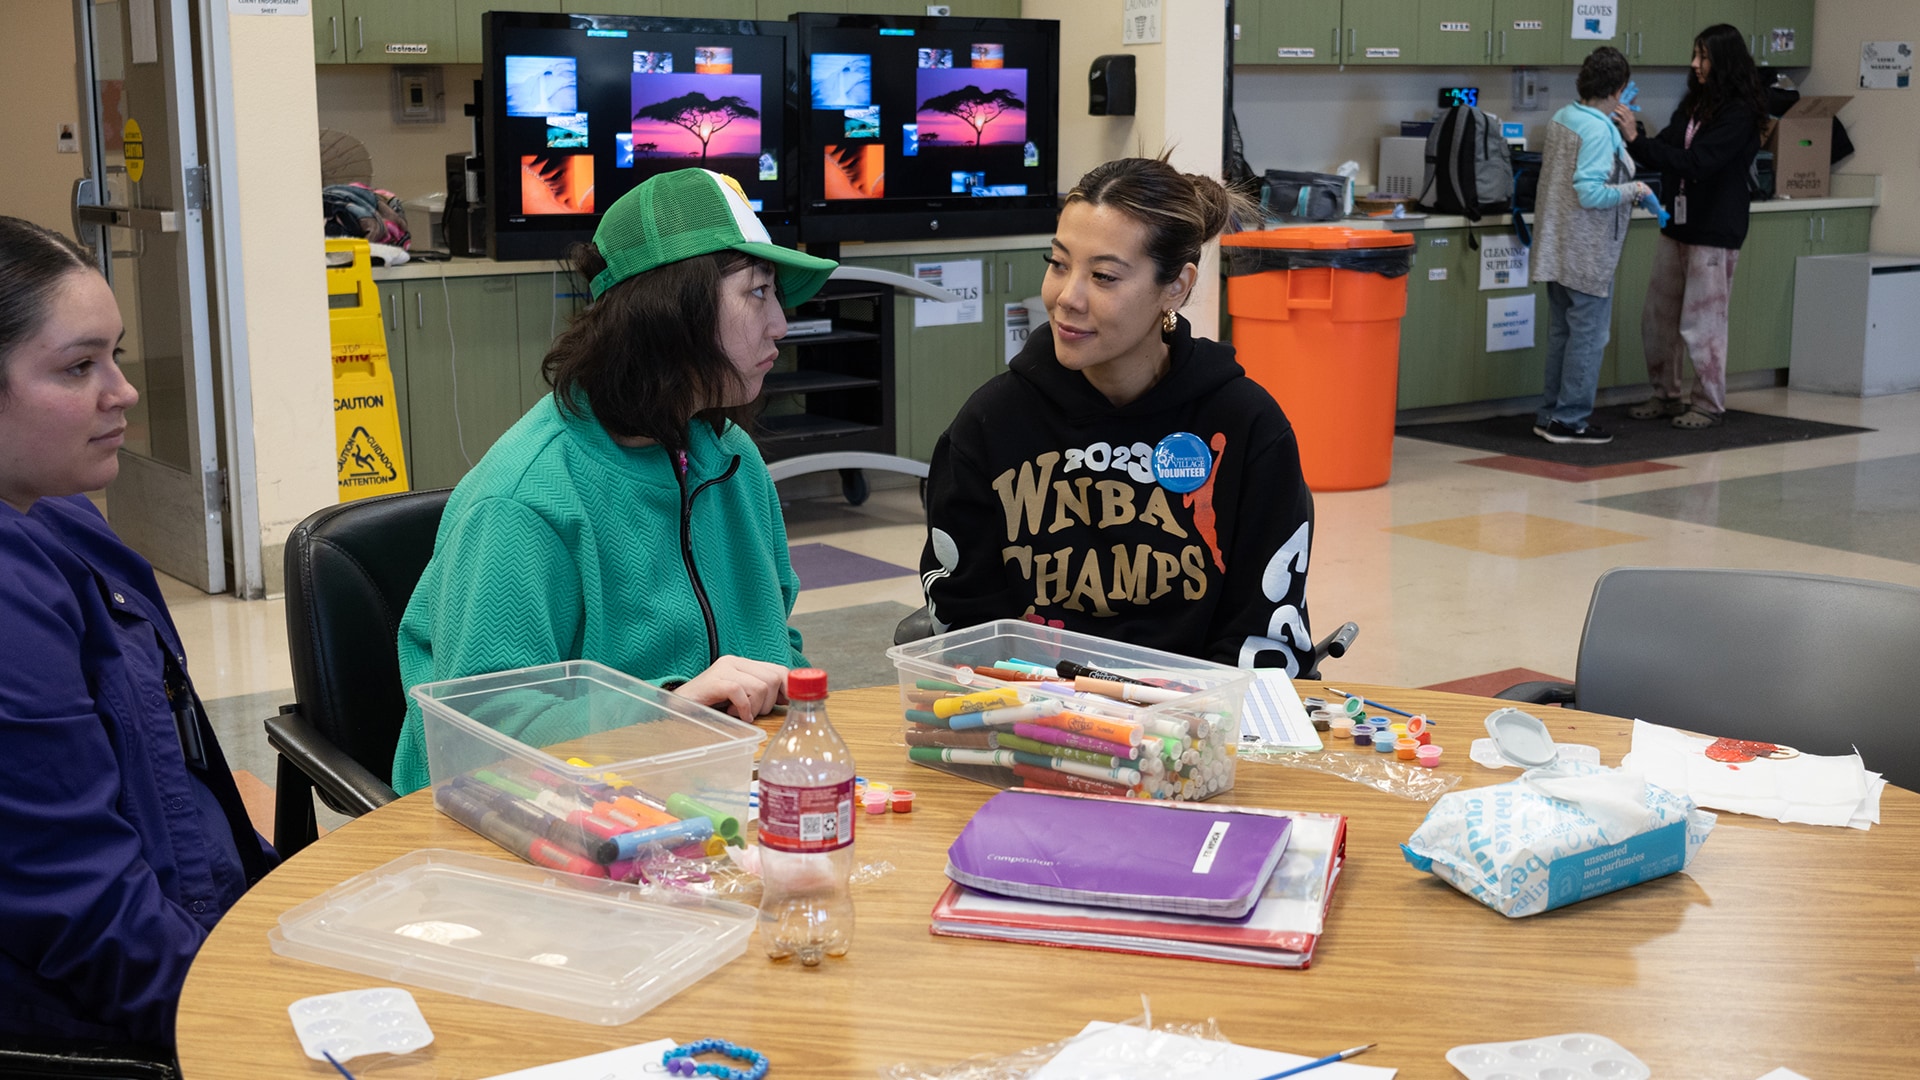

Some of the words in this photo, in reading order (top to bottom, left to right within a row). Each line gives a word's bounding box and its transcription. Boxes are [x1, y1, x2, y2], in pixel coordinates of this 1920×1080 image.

[1577, 5, 1612, 16] GLOVES
[1484, 248, 1525, 258] CLEANING
[1486, 260, 1523, 270] SUPPLIES
[333, 395, 384, 411] CAUTION
[337, 437, 355, 473] CAUTION
[367, 436, 393, 469] CUIDADO
[1064, 442, 1157, 484] 2023
[342, 476, 389, 487] ATTENTION
[1159, 468, 1206, 478] VOLUNTEER
[992, 451, 1188, 542] WNBA
[1583, 844, 1628, 867] unscented
[1584, 868, 1600, 879] non
[1601, 852, 1645, 875] parfumées
